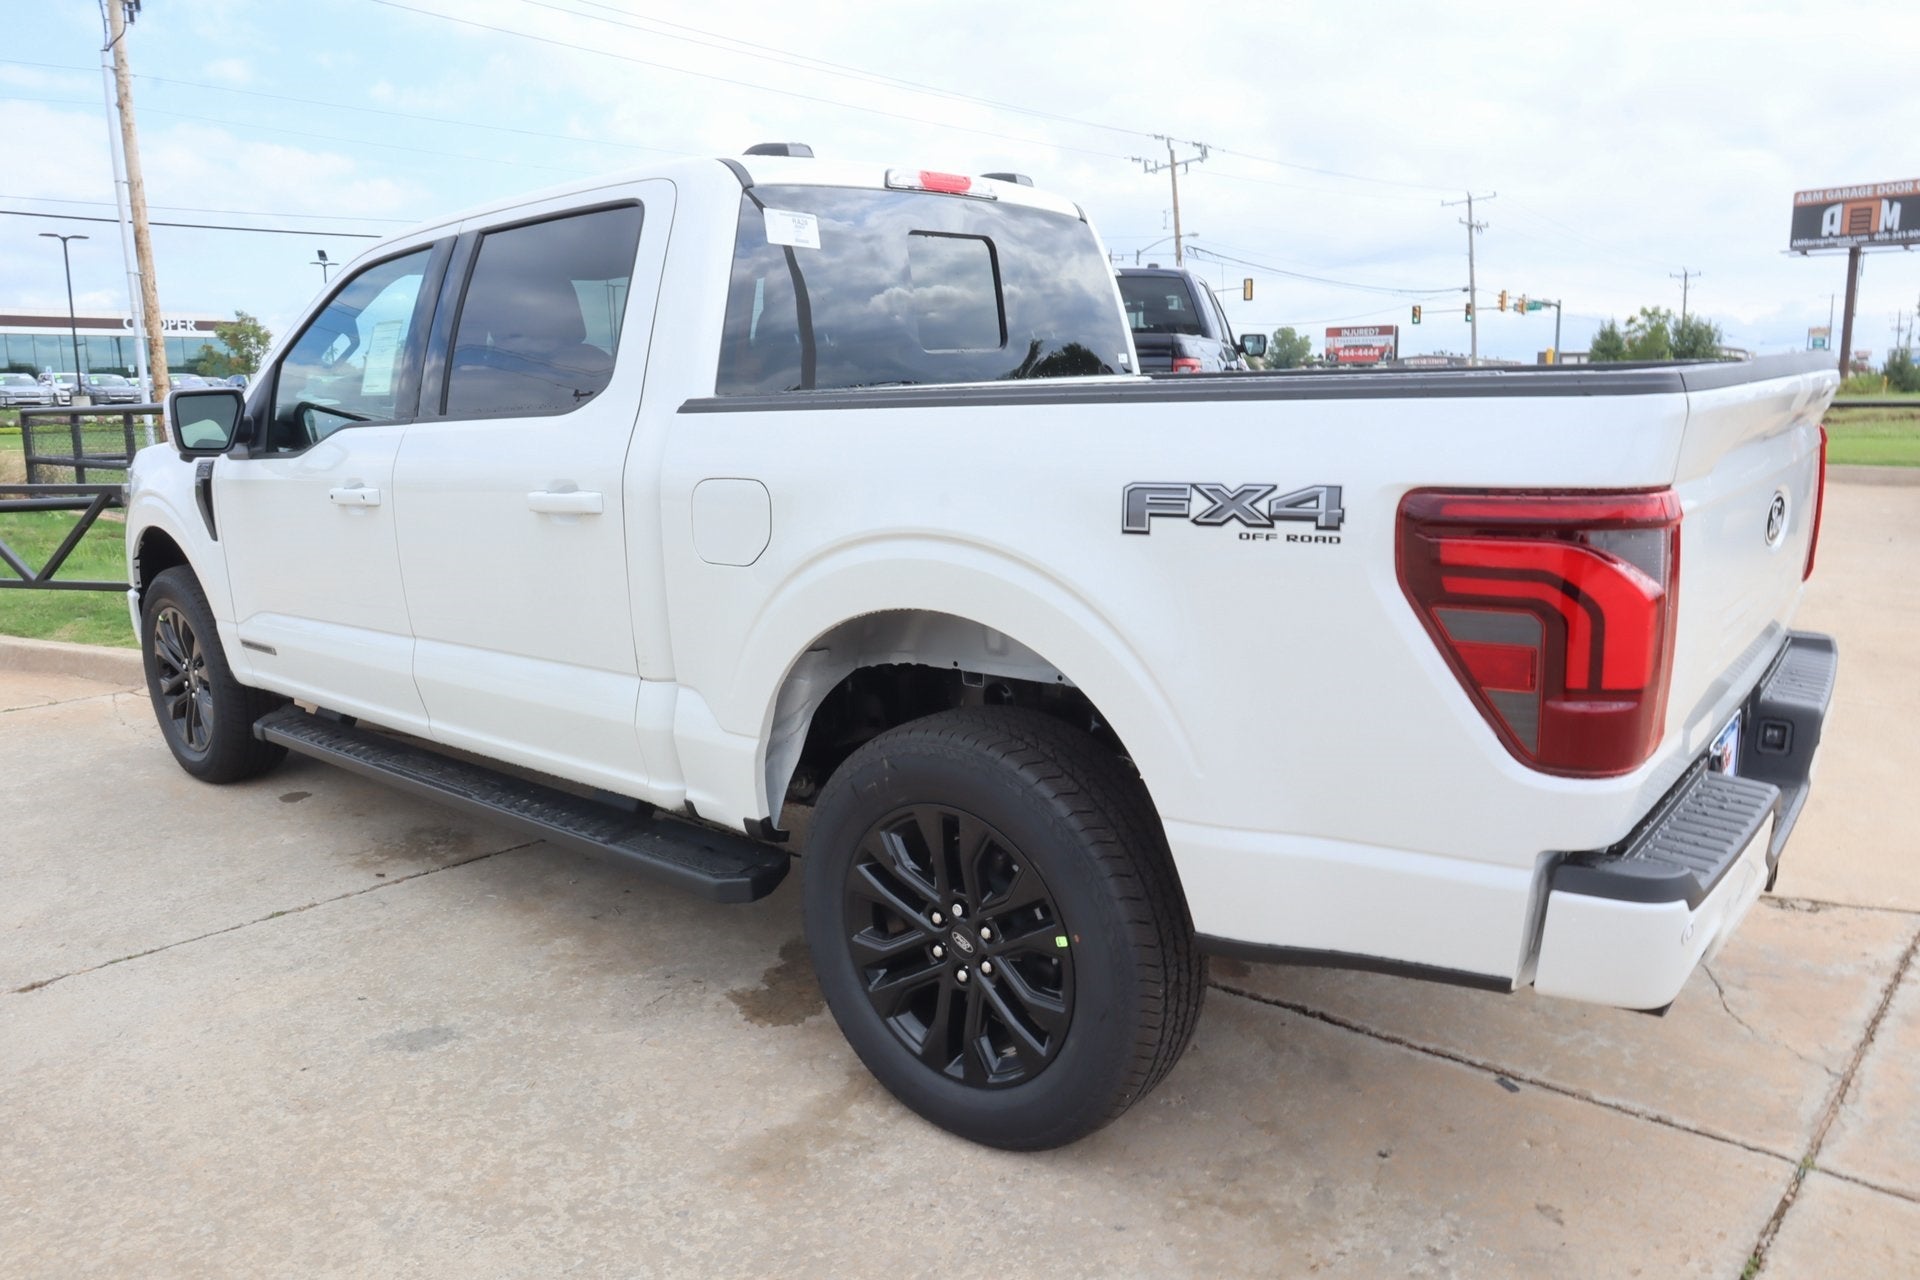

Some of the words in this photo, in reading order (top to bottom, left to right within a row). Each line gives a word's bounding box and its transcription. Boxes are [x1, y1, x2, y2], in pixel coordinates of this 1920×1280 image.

[1826, 186, 1873, 199] GARAGE
[1877, 182, 1914, 196] DOOR
[123, 318, 197, 331] CPER
[1341, 327, 1380, 336] INJURED?
[1121, 482, 1345, 535] FX4
[1239, 532, 1278, 542] OFF
[1286, 534, 1342, 545] ROAD
